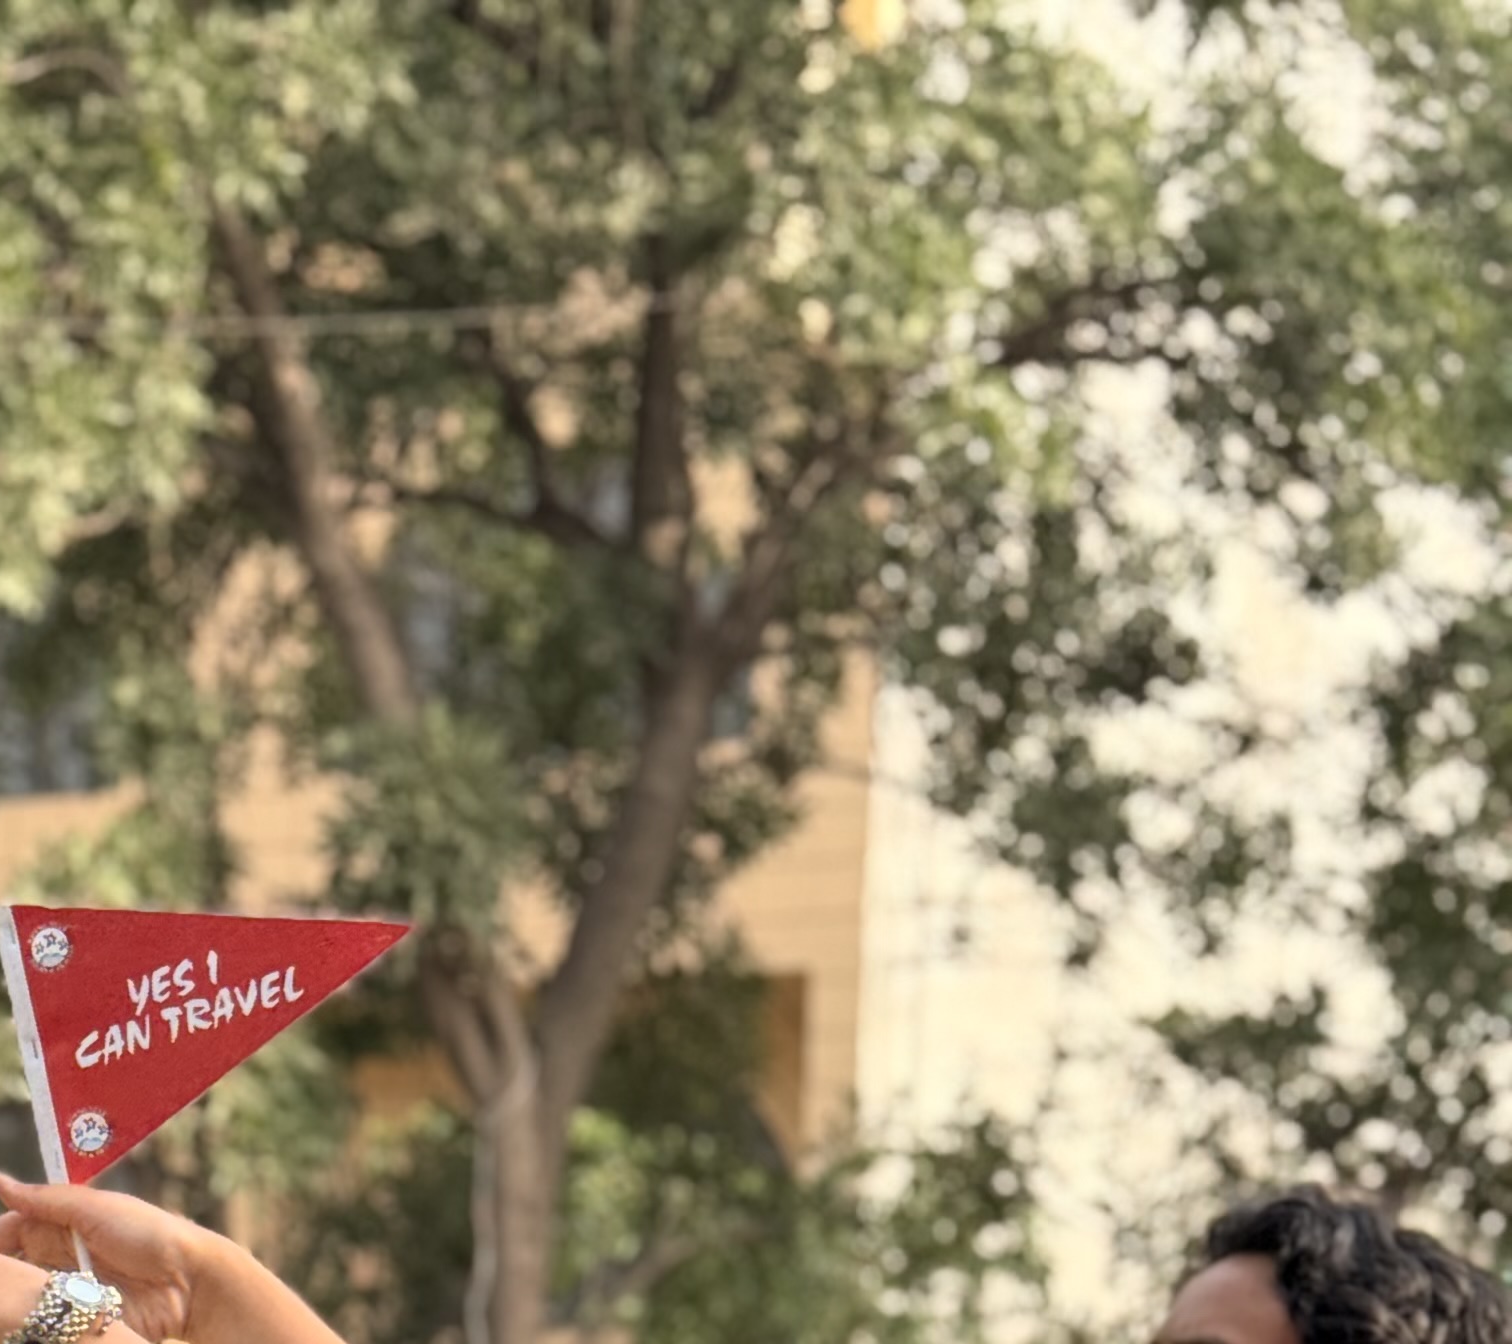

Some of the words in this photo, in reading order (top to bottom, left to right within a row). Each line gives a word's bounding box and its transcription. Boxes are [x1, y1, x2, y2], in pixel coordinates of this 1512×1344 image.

[74, 1015, 152, 1070] CAN
[159, 966, 305, 1044] TRAVEL
[127, 958, 194, 1017] YES
[206, 949, 219, 985] I
